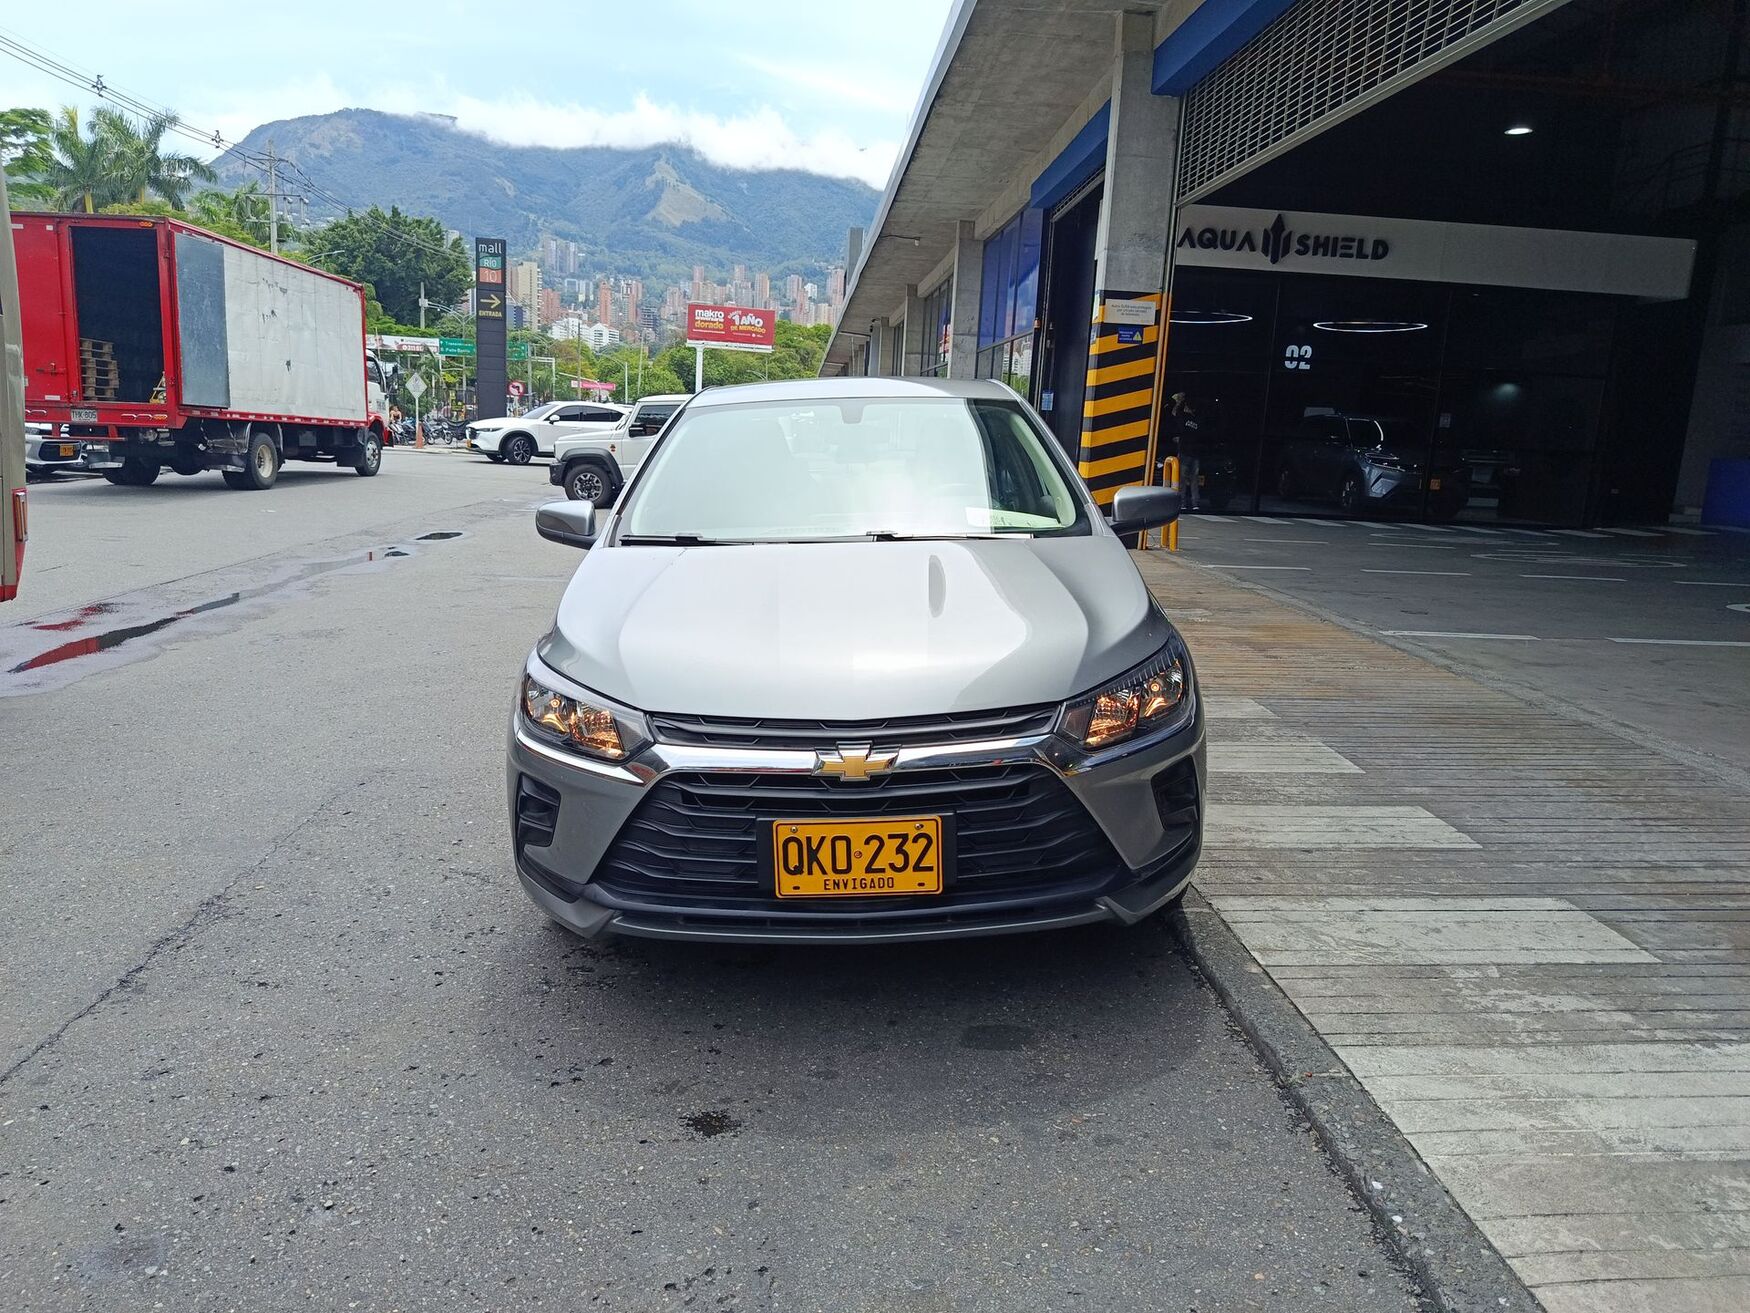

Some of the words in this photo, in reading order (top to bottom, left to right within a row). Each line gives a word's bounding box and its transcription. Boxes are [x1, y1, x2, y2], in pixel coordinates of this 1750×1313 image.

[478, 243, 502, 254] mall
[1176, 227, 1256, 252] AQUA
[1294, 233, 1389, 260] SHIELD
[484, 270, 497, 283] 10
[479, 310, 502, 318] ENTRADA
[695, 309, 724, 318] makro
[740, 313, 763, 327] AÑO
[695, 320, 724, 329] dorado
[1284, 345, 1312, 370] 02
[823, 876, 895, 891] ENVIGADO
